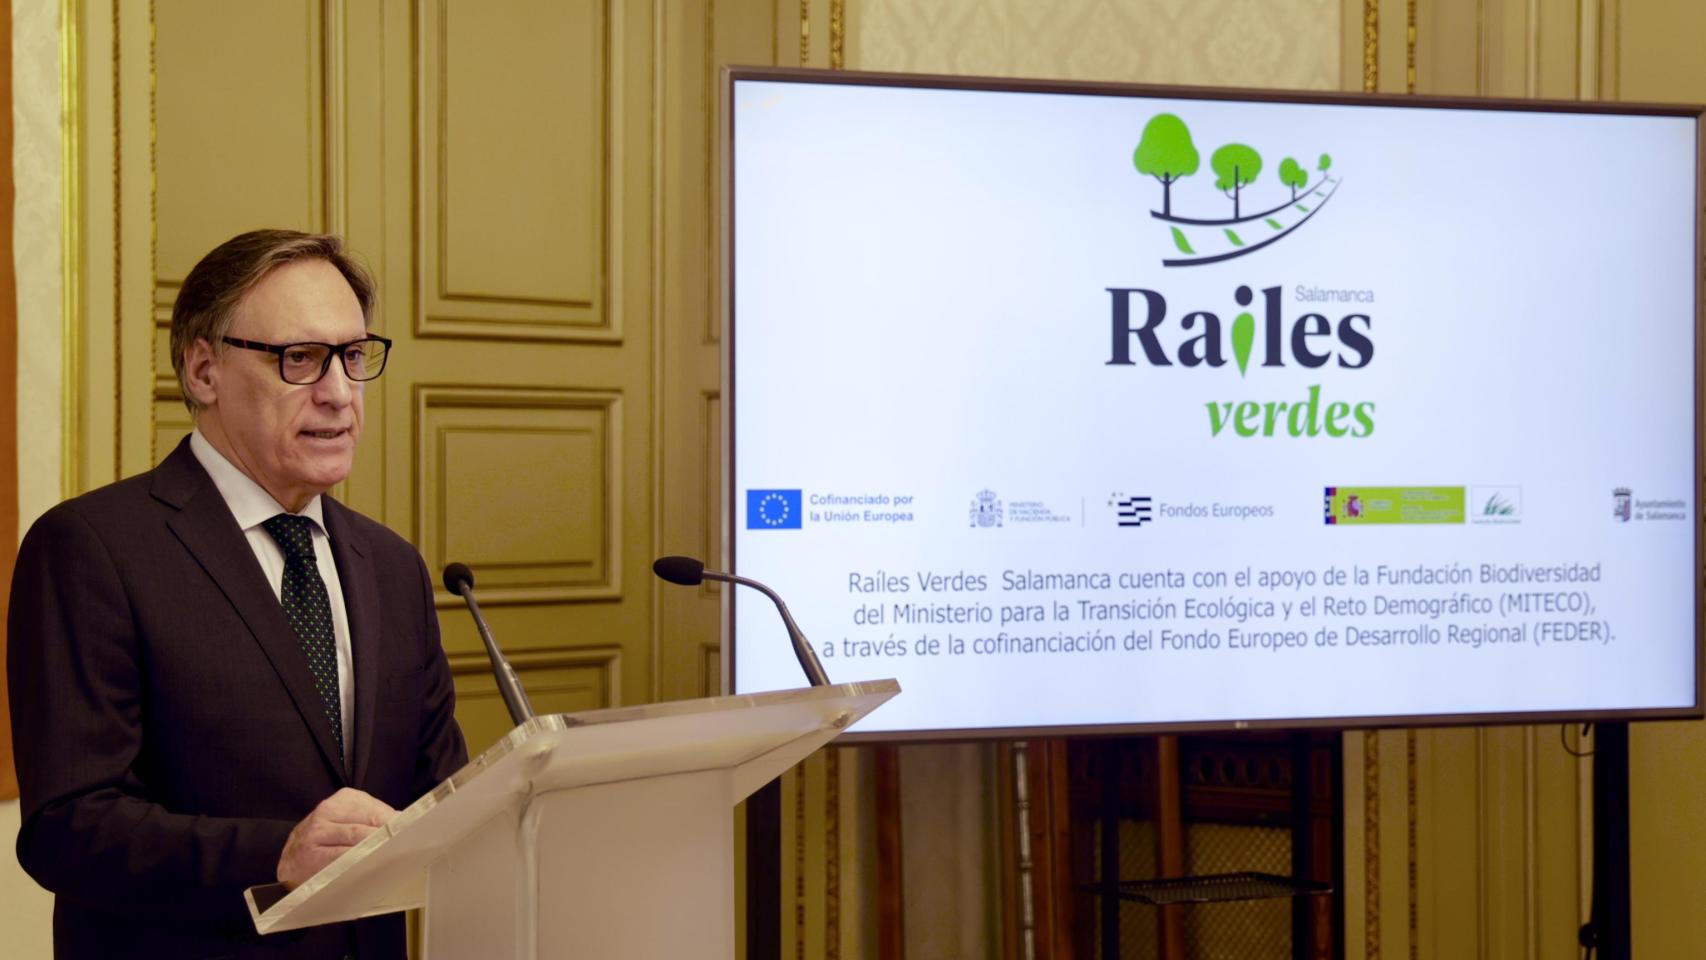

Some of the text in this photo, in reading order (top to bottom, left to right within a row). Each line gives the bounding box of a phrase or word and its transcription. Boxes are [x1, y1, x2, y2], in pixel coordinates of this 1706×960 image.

[1295, 285, 1375, 303] Salamanca
[1204, 384, 1376, 438] verdes
[809, 493, 914, 508] Cofinanciado por
[1160, 502, 1274, 520] Fondos Europeos
[809, 510, 914, 524] la Unión Europea
[849, 562, 1601, 593] Raíles Verdes Salamanca cuenta con el apoyo de la Fundación Biodiversidad
[853, 592, 1595, 627] del Ministerio para la Transición Ecológica y el Reto Demográfico (MITECO),
[823, 621, 1616, 658] a través de la cofinanciación del Fondo Europeo de Desarrollo Regional (FEDER).
